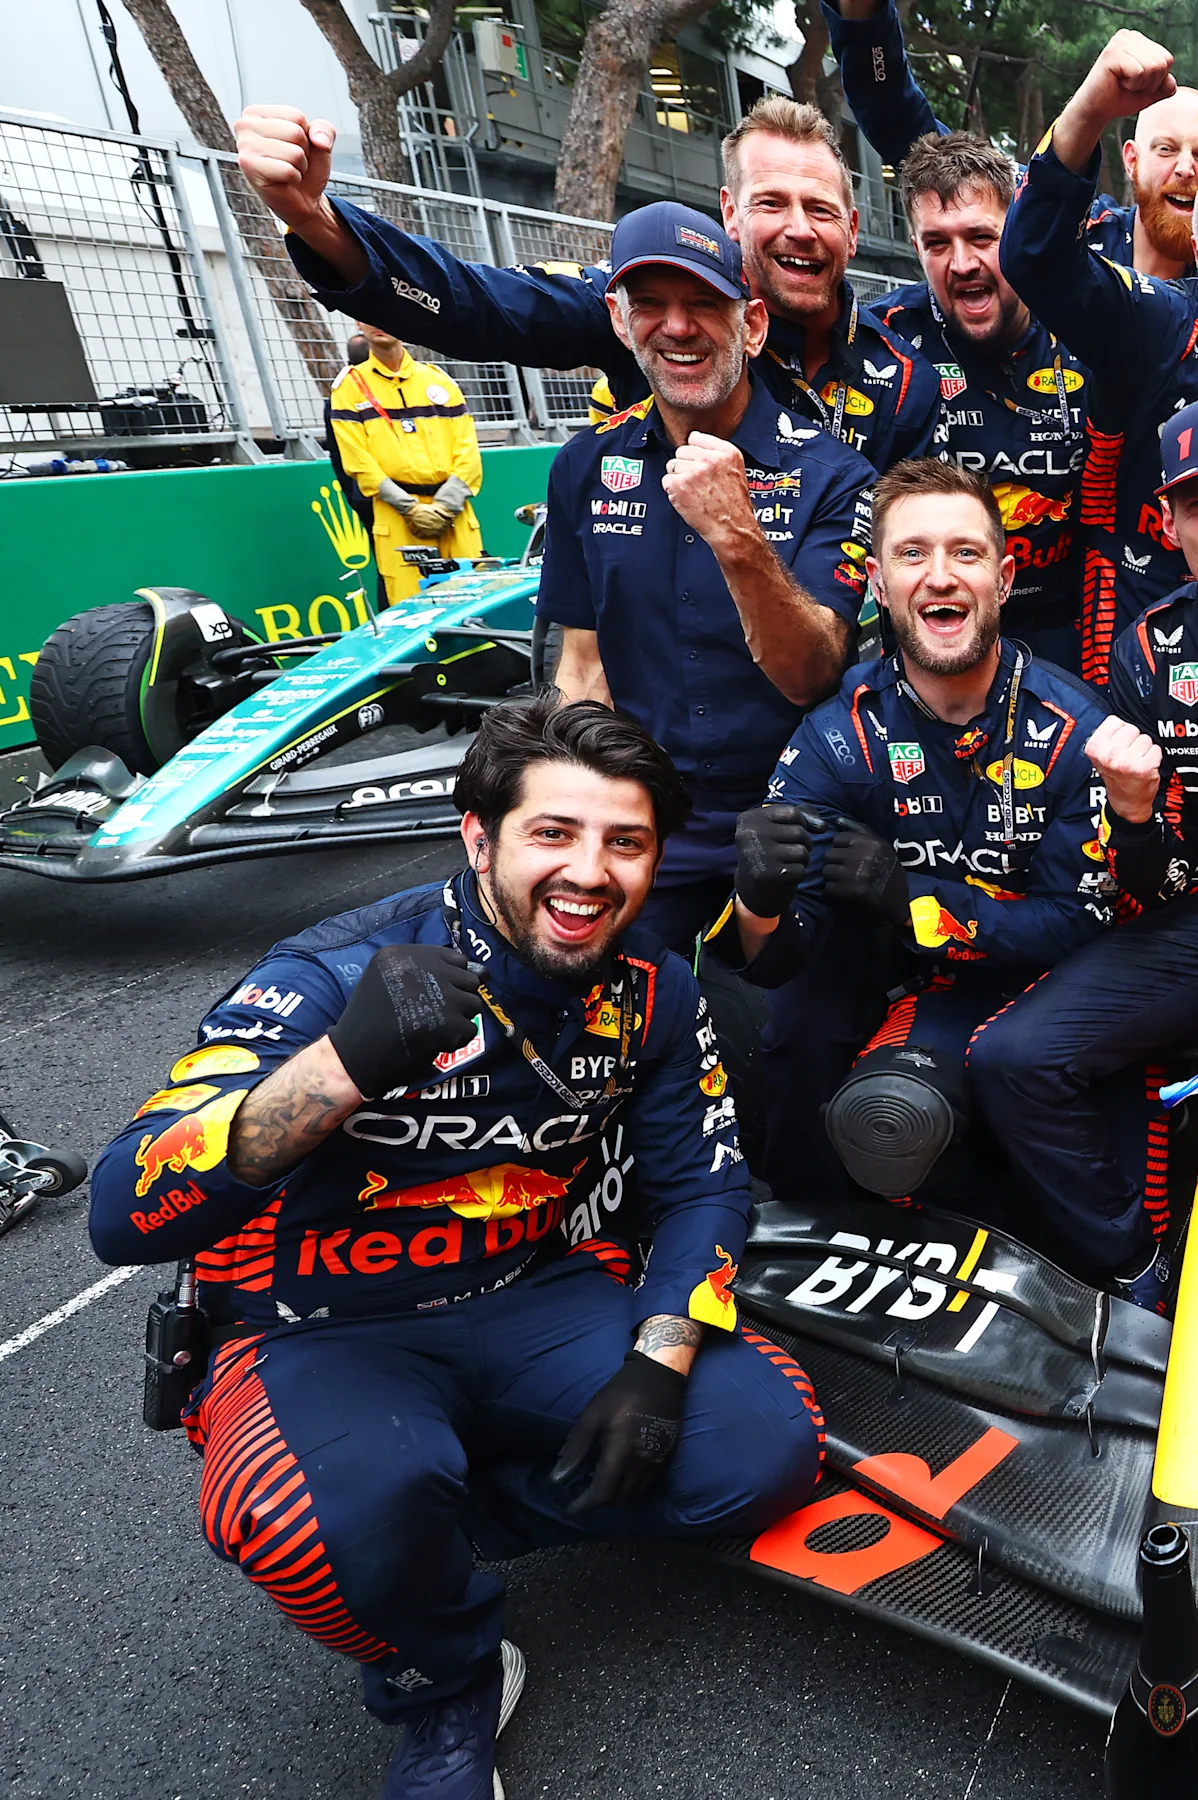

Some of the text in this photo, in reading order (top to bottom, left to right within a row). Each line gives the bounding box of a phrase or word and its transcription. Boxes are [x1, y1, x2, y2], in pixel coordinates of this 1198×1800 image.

[1177, 427, 1193, 461] 1
[604, 457, 641, 473] TAG
[602, 471, 640, 490] HEUER
[750, 490, 801, 499] ACING
[591, 500, 628, 517] Mobil
[593, 523, 643, 536] ORACLE
[227, 984, 304, 1019] Mobil
[130, 1180, 209, 1235] Red Bull
[294, 1218, 463, 1275] Red
[785, 1228, 1019, 1353] BYBIT
